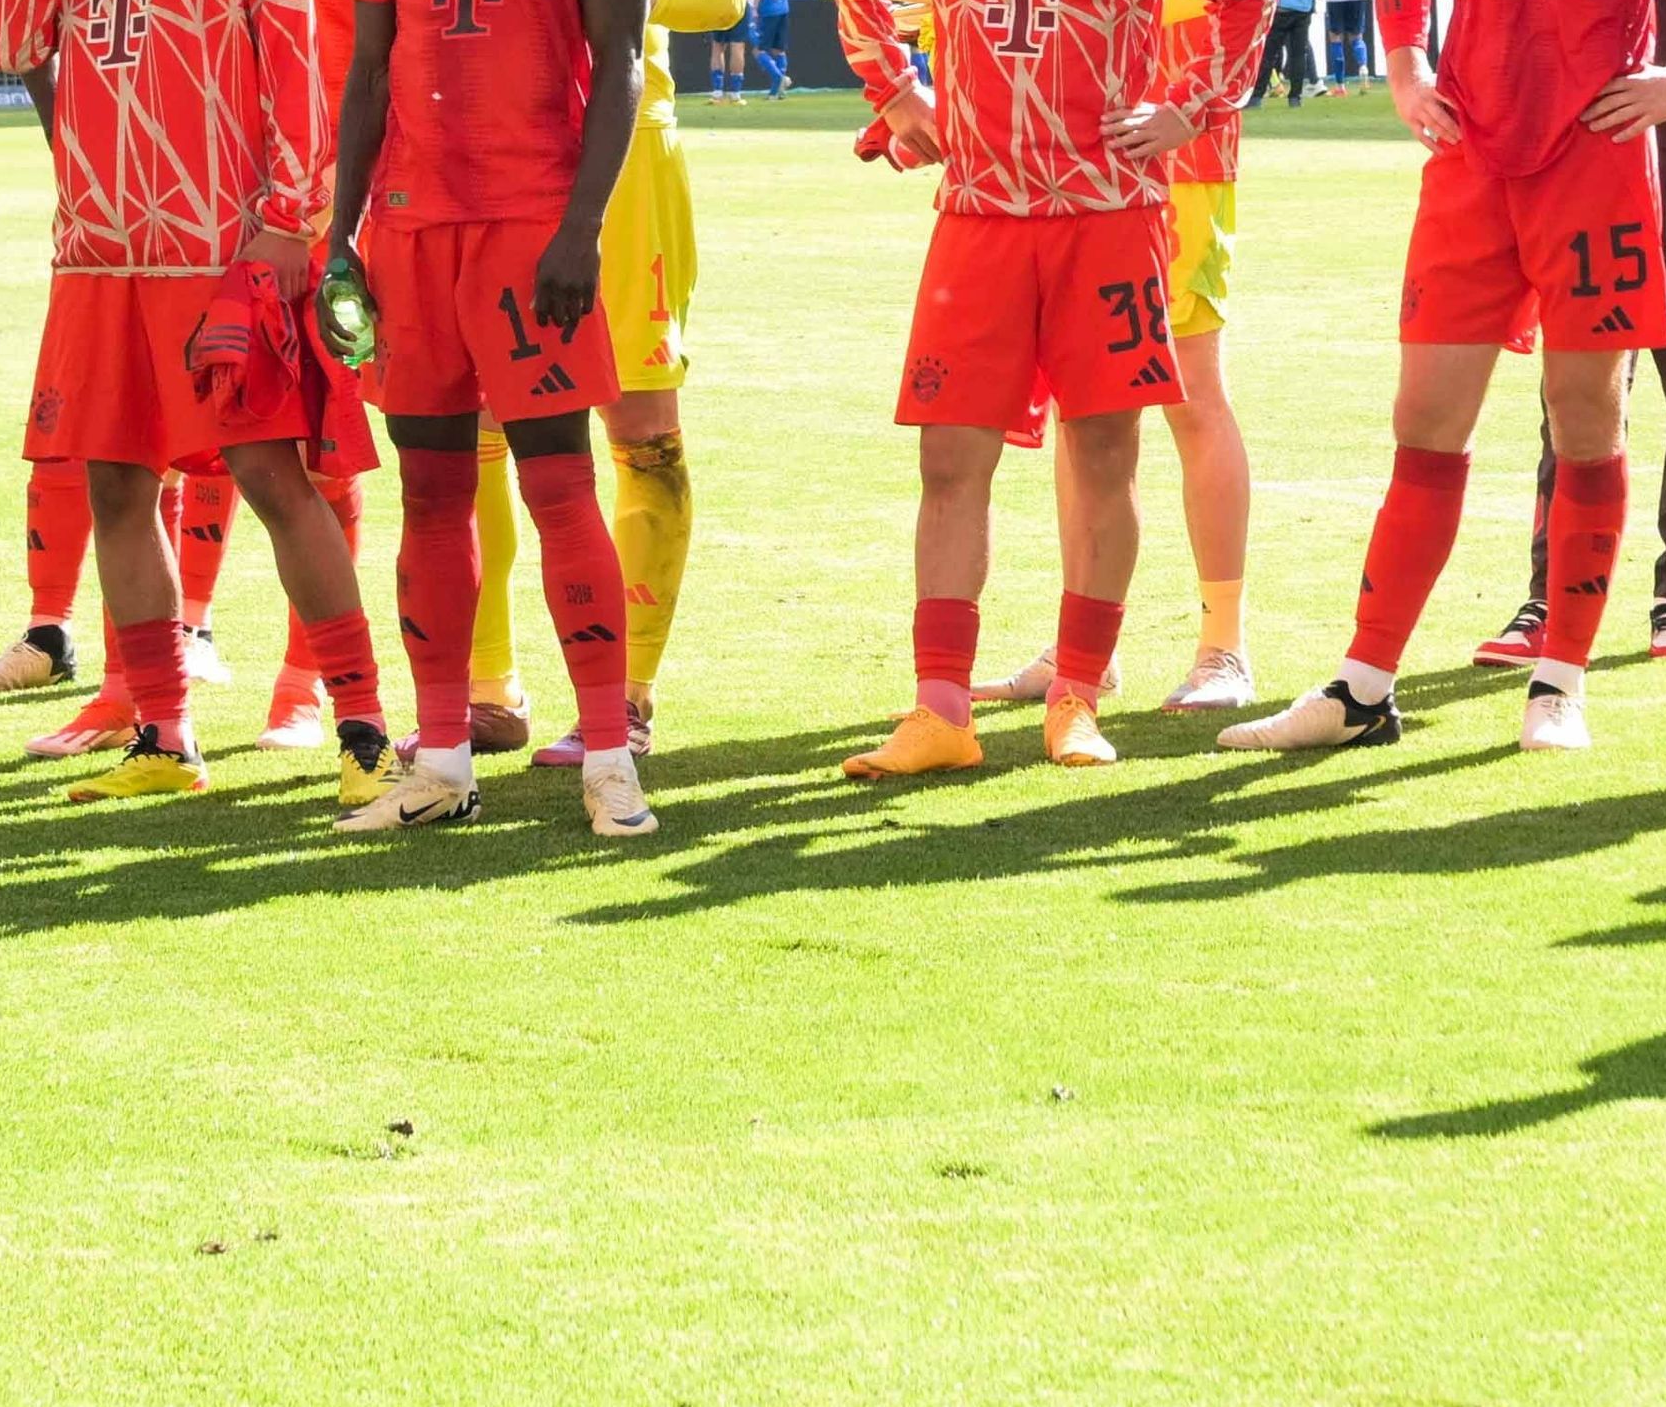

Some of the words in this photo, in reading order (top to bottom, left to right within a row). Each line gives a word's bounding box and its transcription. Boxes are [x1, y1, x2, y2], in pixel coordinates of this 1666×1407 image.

[650, 253, 670, 322] 1
[1569, 222, 1648, 298] 15
[1098, 276, 1168, 353] 38
